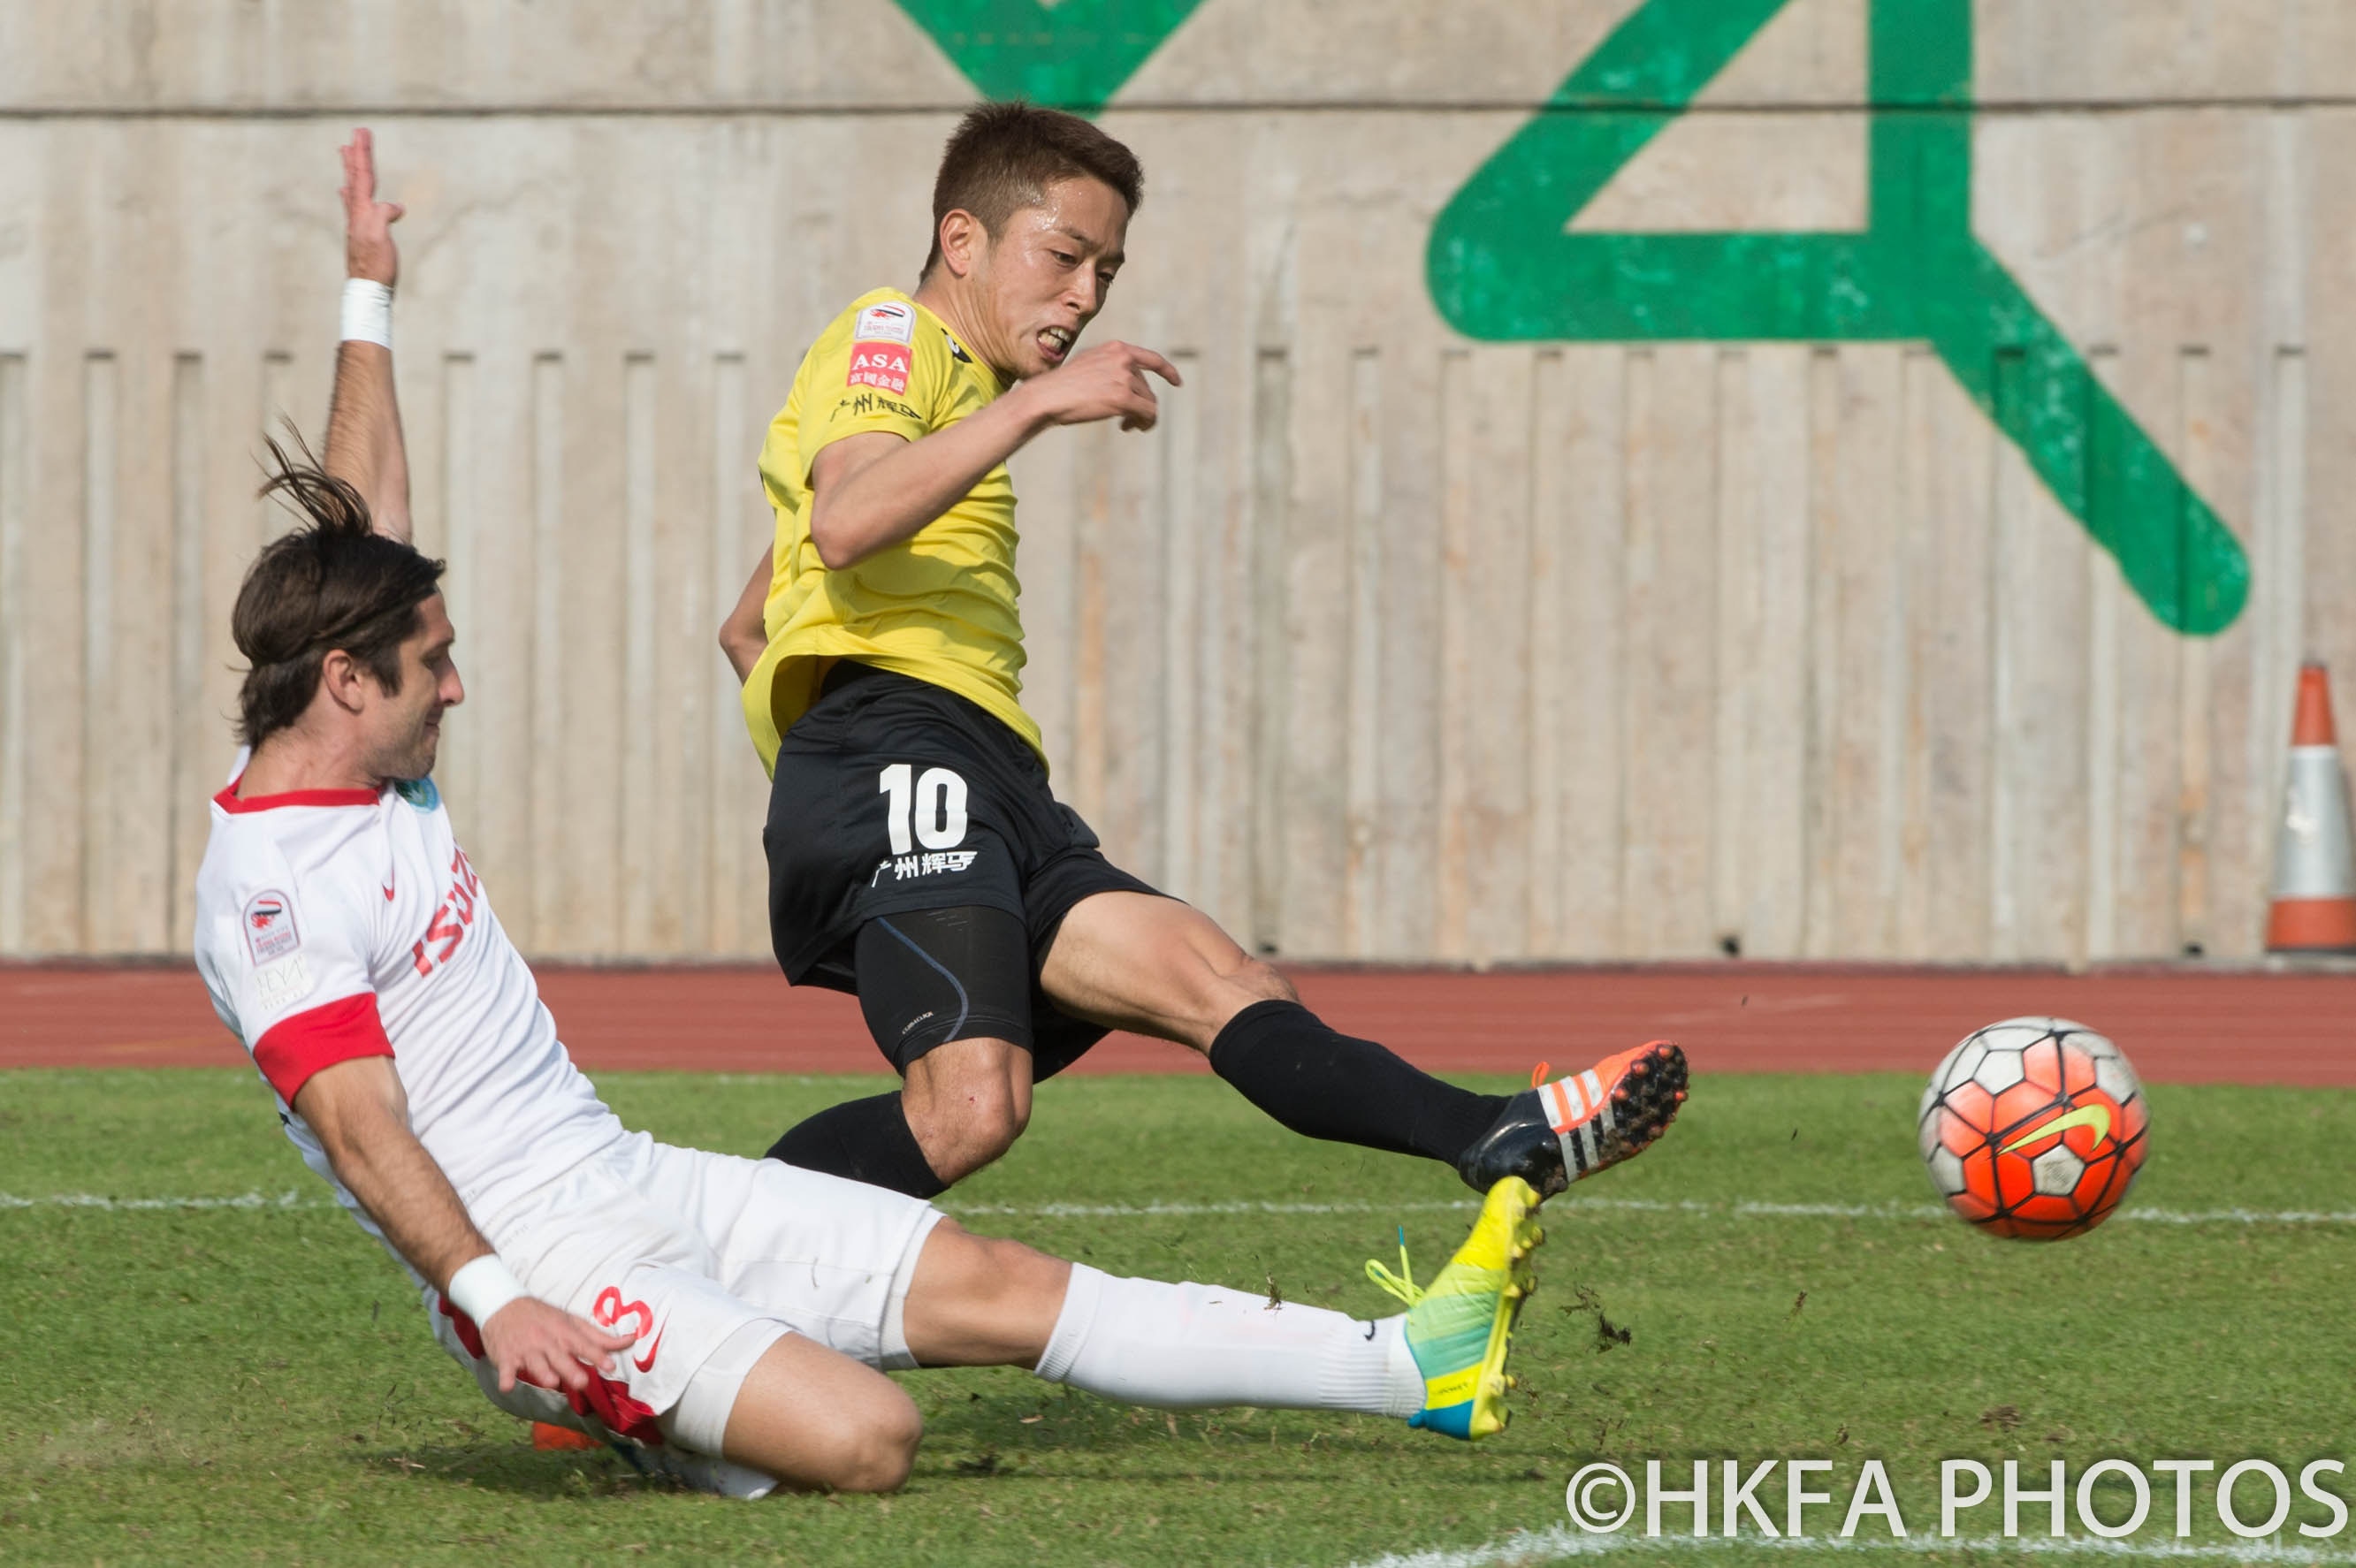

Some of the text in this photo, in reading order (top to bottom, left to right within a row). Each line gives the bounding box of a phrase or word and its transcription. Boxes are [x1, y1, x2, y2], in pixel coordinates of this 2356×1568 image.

[853, 354, 907, 373] ASA
[880, 764, 968, 855] 10
[412, 848, 477, 978] ISUZ
